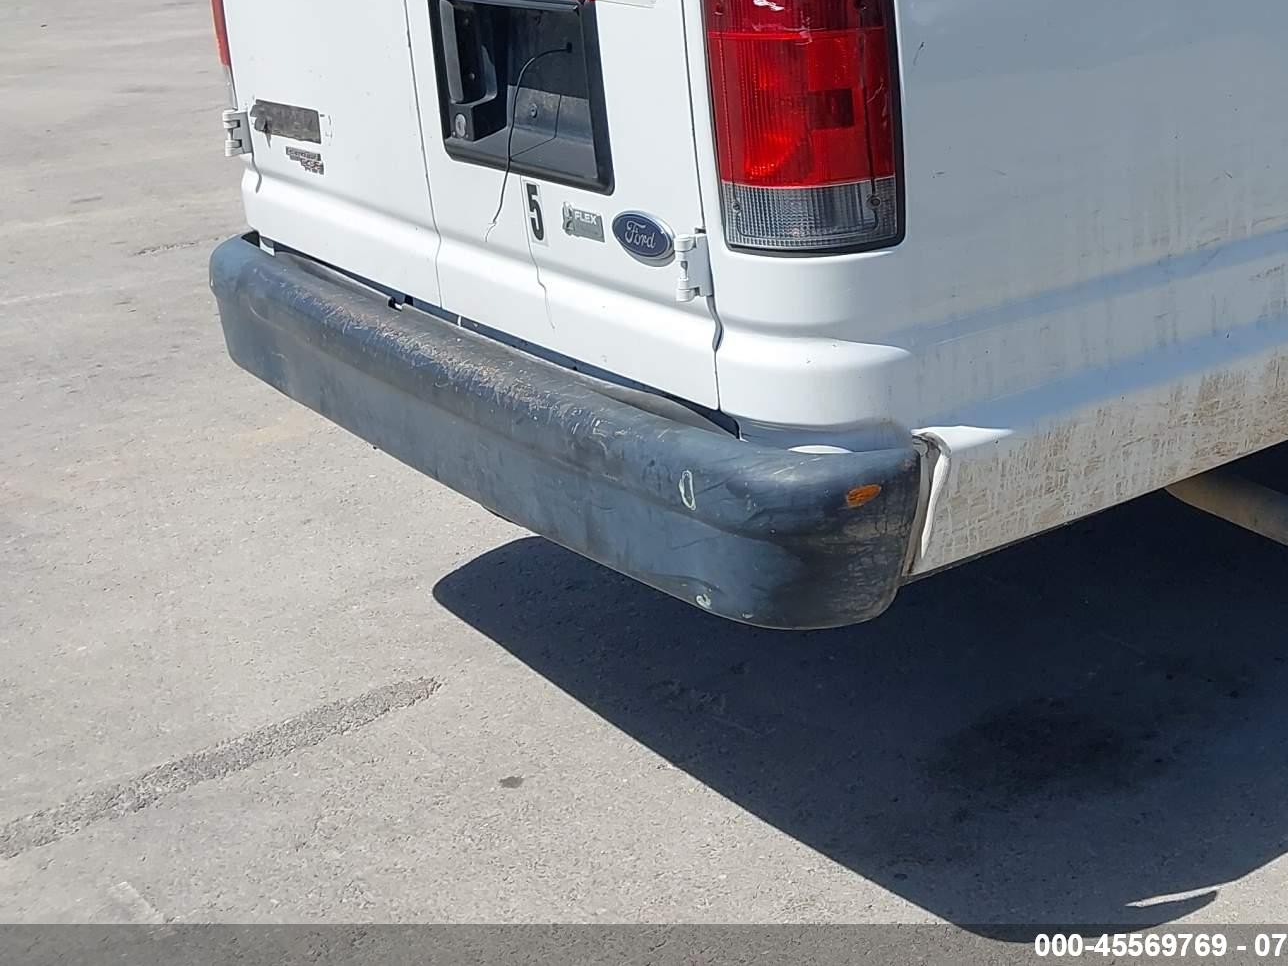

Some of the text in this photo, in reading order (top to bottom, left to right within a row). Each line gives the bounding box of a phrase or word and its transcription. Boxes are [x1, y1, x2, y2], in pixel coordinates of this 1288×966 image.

[526, 183, 543, 241] 5
[573, 210, 598, 226] FLEX
[624, 219, 656, 250] Ford
